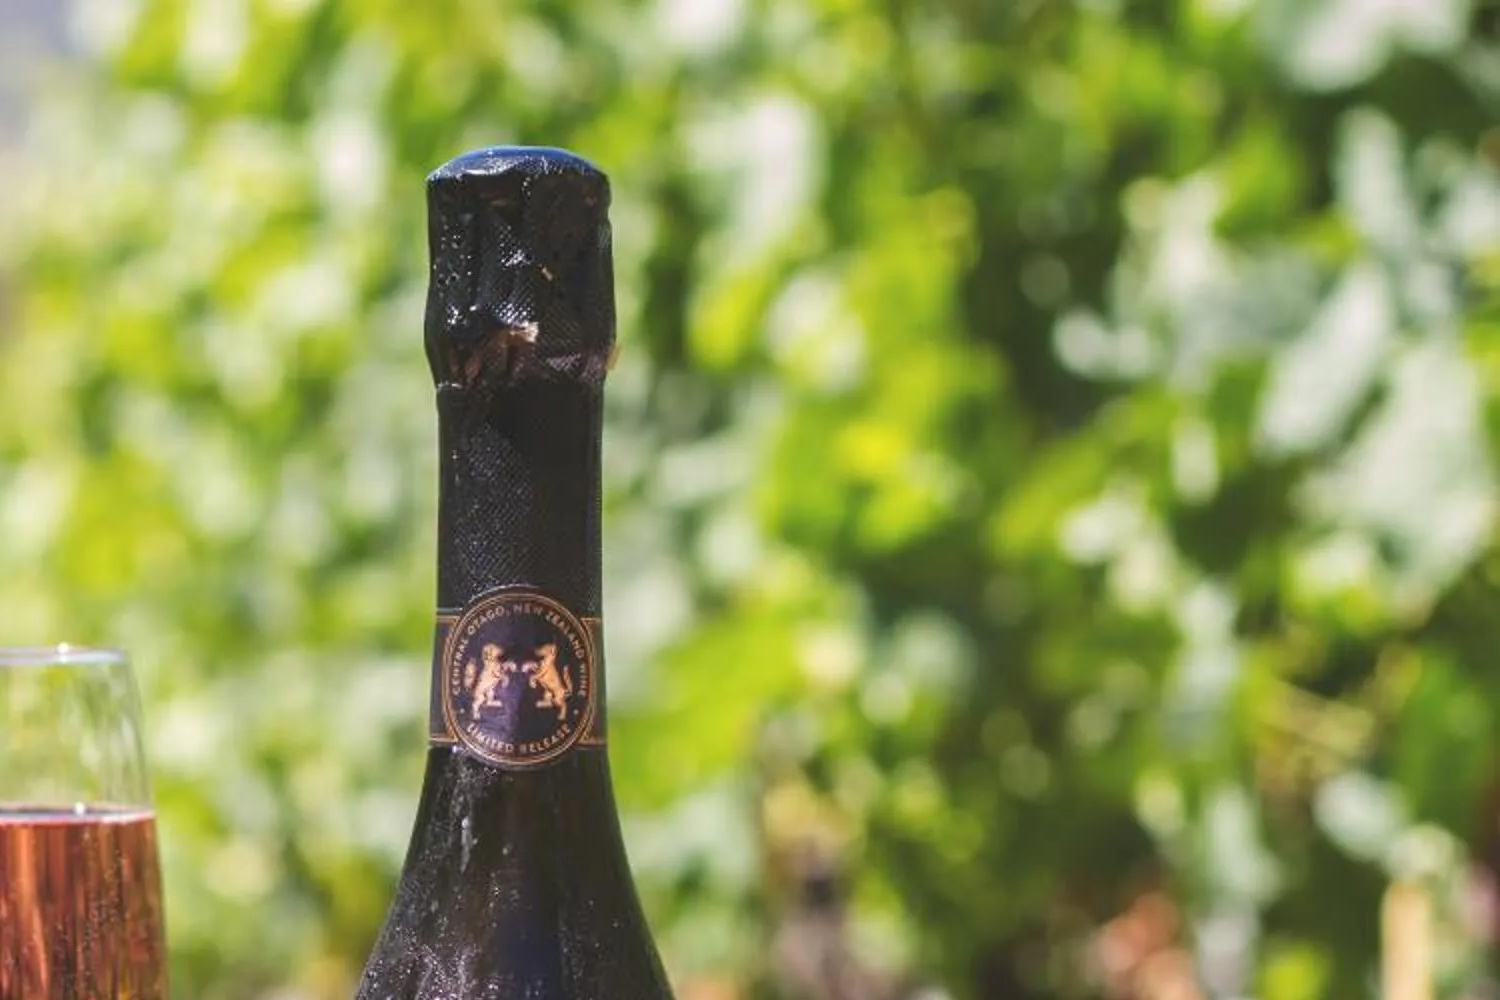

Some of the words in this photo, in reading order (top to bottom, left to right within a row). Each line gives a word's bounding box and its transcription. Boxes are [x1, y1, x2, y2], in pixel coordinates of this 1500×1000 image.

[513, 603, 543, 616] NEW
[545, 611, 585, 660] ZEALAND
[467, 722, 514, 753] LIMITED
[520, 723, 571, 754] RELEASE
